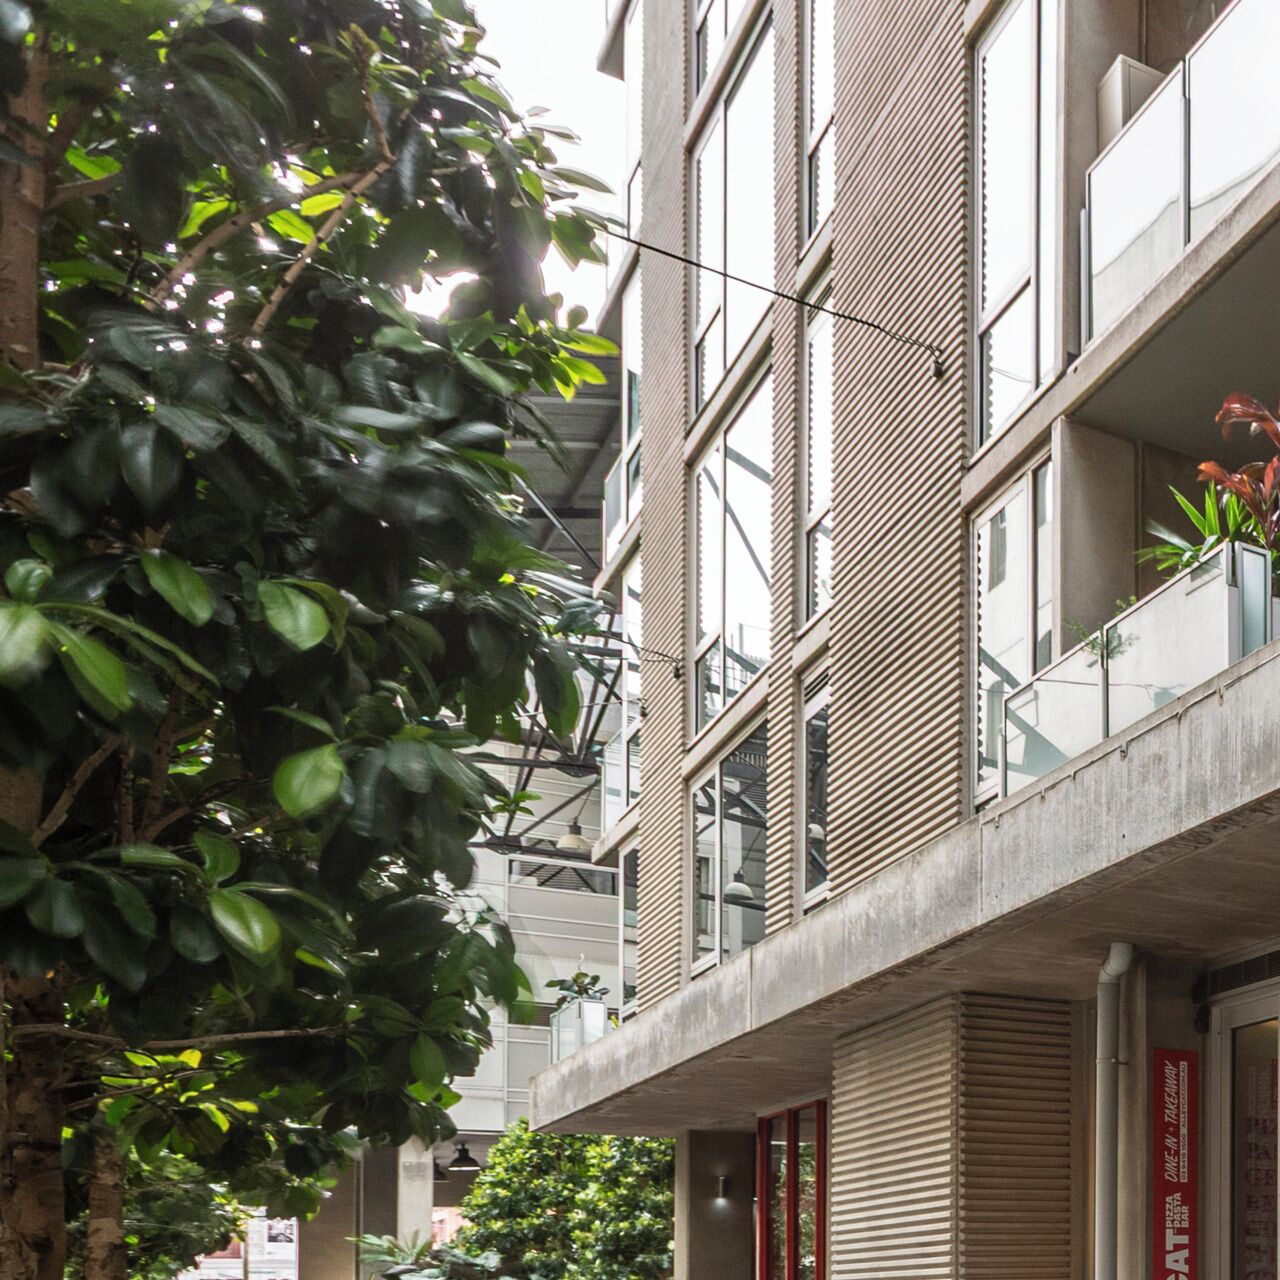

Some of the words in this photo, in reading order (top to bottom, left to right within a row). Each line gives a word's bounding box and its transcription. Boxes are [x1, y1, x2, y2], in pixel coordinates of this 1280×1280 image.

[1164, 1059, 1179, 1125] TAKEAWAY
[1164, 1133, 1179, 1183] DINE-IN
[1165, 1195, 1174, 1228] PIZZA
[1173, 1192, 1182, 1228] PASTA
[1181, 1205, 1190, 1228] BAR
